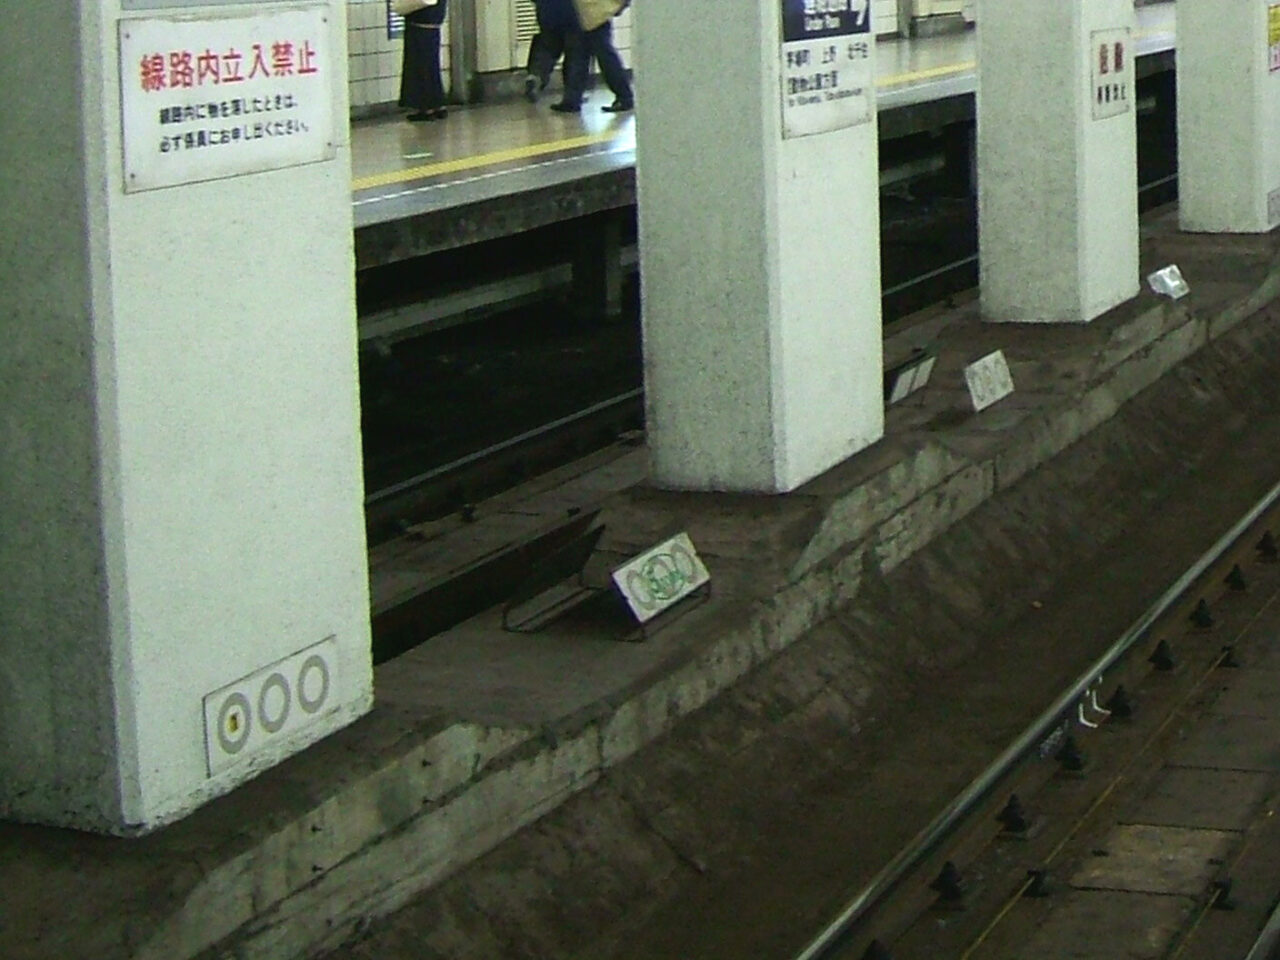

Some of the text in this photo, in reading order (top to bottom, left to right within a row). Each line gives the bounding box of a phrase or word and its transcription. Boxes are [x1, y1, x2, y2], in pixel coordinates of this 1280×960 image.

[140, 39, 319, 92] 線路内立入禁止
